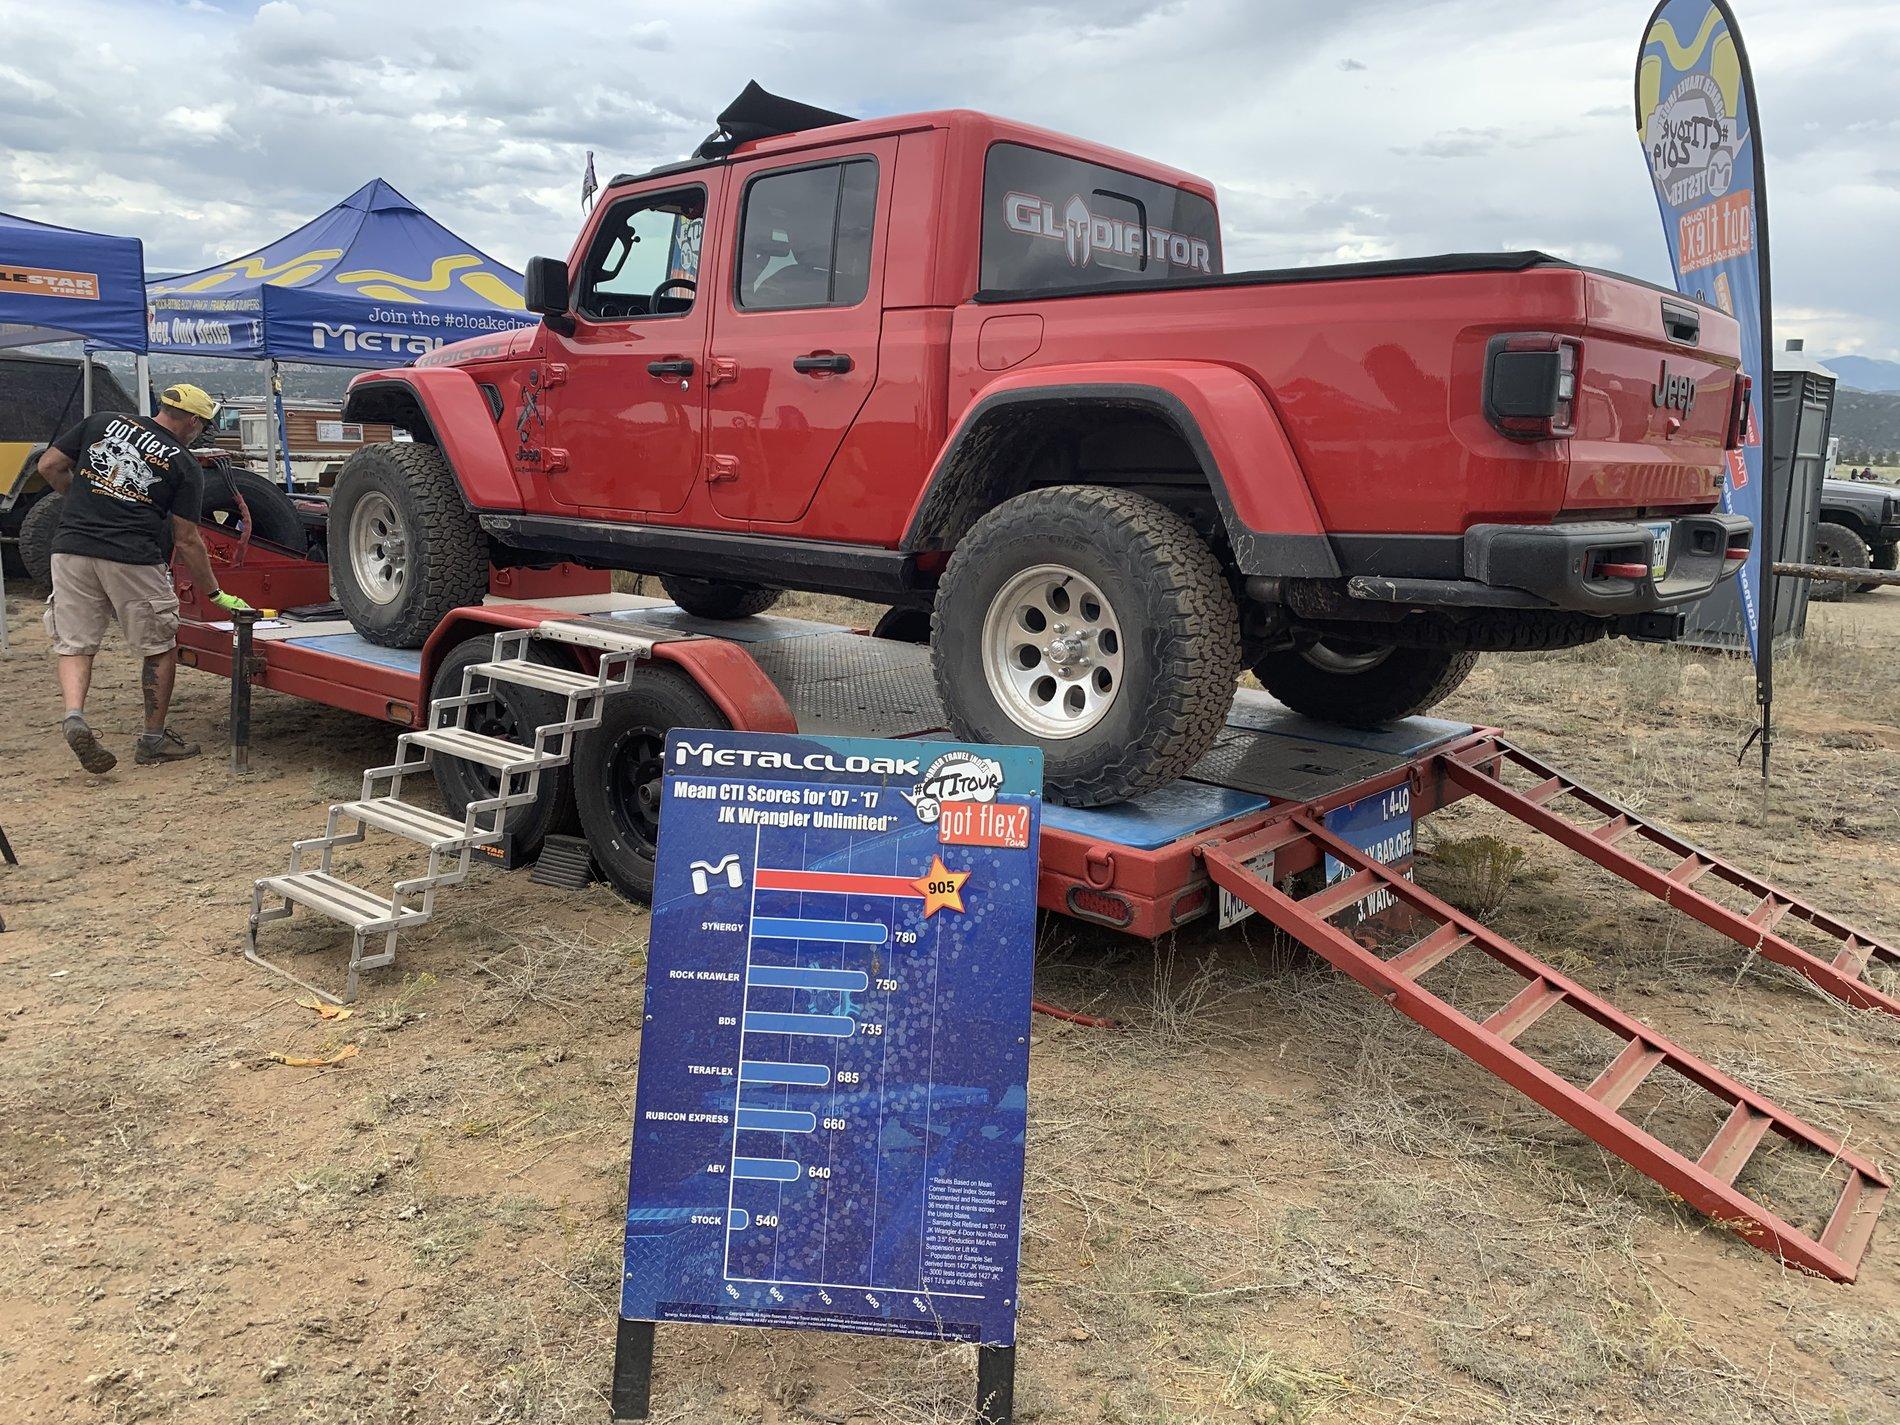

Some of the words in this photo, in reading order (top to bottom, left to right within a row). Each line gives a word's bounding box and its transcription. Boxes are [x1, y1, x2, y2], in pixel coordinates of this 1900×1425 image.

[50, 286, 94, 296] TIRES
[369, 307, 408, 324] Join
[412, 311, 440, 326] the
[172, 317, 197, 346] Only
[196, 319, 232, 345] Better
[1652, 359, 1697, 420] Jeep
[104, 420, 137, 441] got
[135, 431, 181, 461] flex?
[144, 453, 170, 471] TOUR
[943, 751, 970, 763] TRAVEL
[969, 754, 990, 774] INDEX
[674, 781, 717, 800] Mean
[720, 783, 745, 801] CTI
[747, 785, 801, 804] Scores
[803, 788, 826, 805] for
[1389, 787, 1410, 817] 4-LO
[717, 806, 736, 823] JK
[738, 807, 811, 828] Wrangler
[941, 805, 973, 841] got
[980, 804, 1028, 839] flex?
[1377, 837, 1394, 865] BAR
[1396, 829, 1411, 858] OFF
[928, 881, 955, 895] 905
[701, 922, 744, 932] SYNERGY
[895, 931, 917, 944] 780
[669, 970, 695, 980] ROCK
[697, 972, 740, 982] KRAWLER
[876, 979, 898, 991] 750
[718, 1017, 737, 1026] BDS
[860, 1023, 883, 1036] 735
[688, 1066, 734, 1076] TERAFLEX
[837, 1071, 860, 1084] 685
[645, 1111, 686, 1122] RUBICON
[689, 1113, 729, 1124] EXPRESS
[823, 1118, 846, 1131] 660
[707, 1164, 725, 1174] AEV
[808, 1167, 831, 1179] 640
[954, 1178, 970, 1186] Based
[978, 1180, 993, 1188] Mean
[929, 1185, 946, 1193] Corner
[947, 1186, 963, 1194] Travel
[963, 1187, 977, 1195] Index
[978, 1189, 996, 1197] Scores
[928, 1193, 960, 1202] Documented
[971, 1196, 996, 1205] Recorded
[935, 1202, 954, 1210] months
[691, 1215, 722, 1226] STOCK
[936, 1210, 953, 1218] United
[755, 1215, 778, 1228] 540
[932, 1219, 951, 1227] Sample
[961, 1221, 981, 1229] Refined
[934, 1227, 957, 1236] Wrangler
[948, 1236, 975, 1245] Production
[925, 1243, 955, 1252] Suspension
[930, 1251, 956, 1260] Population
[963, 1254, 983, 1263] Sample
[924, 1260, 943, 1268] derived
[957, 1262, 970, 1270] 1427
[978, 1264, 1004, 1273] Wranglers
[929, 1268, 943, 1276] 3000
[956, 1270, 977, 1279] included
[978, 1272, 991, 1280] 1427
[725, 1283, 740, 1300] 500
[769, 1286, 784, 1303] 600
[818, 1290, 833, 1306] 700
[865, 1293, 880, 1310] 800
[912, 1296, 927, 1313] 900
